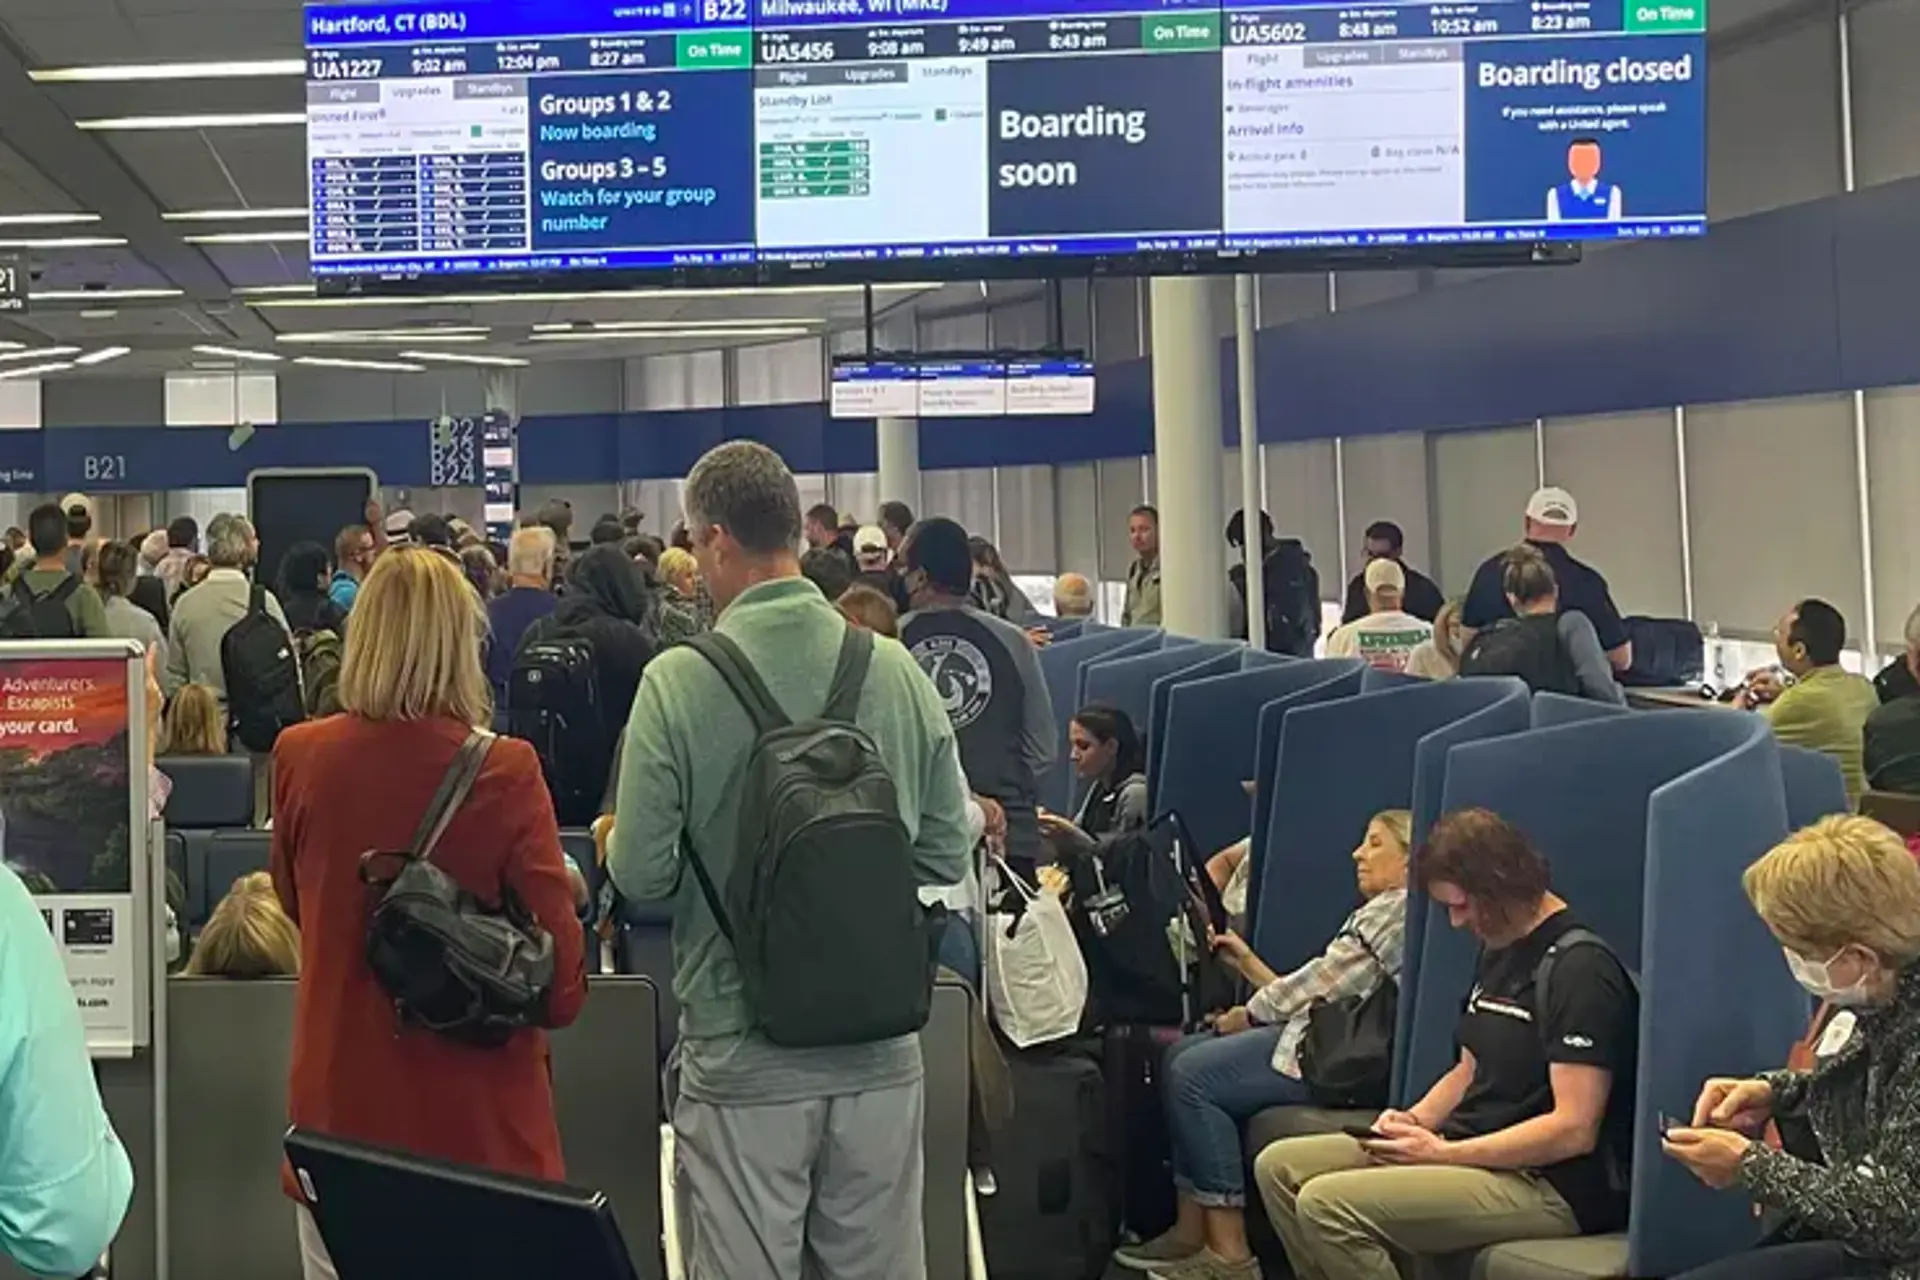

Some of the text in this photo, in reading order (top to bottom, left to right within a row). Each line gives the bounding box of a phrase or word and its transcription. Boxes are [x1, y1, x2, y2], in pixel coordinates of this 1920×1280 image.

[703, 0, 747, 21] B22
[761, 0, 863, 16] Milwaukee,
[867, 0, 890, 13] WI
[1636, 6, 1695, 22] On Time
[311, 12, 467, 35] Hartford, CT (BDL)
[1372, 23, 1398, 35] am
[1430, 19, 1498, 34] 10:52 am
[1531, 15, 1591, 30] 8:23 am
[1153, 25, 1210, 40] On Time
[1230, 23, 1306, 43] UA5602
[900, 42, 925, 54] am
[958, 37, 1015, 53] 9:49 am
[1049, 34, 1107, 49] 8:43 am
[687, 43, 742, 57] On Time
[761, 42, 834, 61] UA5456
[1315, 49, 1370, 64] Upgrades
[1398, 47, 1449, 60] Standbys
[412, 60, 467, 73] 9:02 am
[497, 56, 560, 70] 12:04 pm
[590, 52, 645, 67] 8:27 am
[1247, 53, 1279, 66] Flight
[312, 60, 383, 79] UA1227
[845, 68, 896, 84] Upgrades
[922, 66, 973, 78] Standbys
[1478, 53, 1692, 90] Boarding closed
[779, 71, 808, 85] Flight
[1285, 74, 1354, 90] amenities
[391, 86, 442, 100] Upgrades
[759, 93, 833, 108] Standby List
[540, 89, 672, 118] Groups 1 & 2
[1510, 107, 1527, 119] you
[1529, 105, 1554, 115] need
[1607, 103, 1637, 116] please
[1638, 101, 1667, 114] speak
[540, 124, 579, 140] Now
[581, 120, 657, 142] boarding
[1000, 104, 1147, 144] Boarding
[1227, 121, 1304, 137] Arrival info
[1537, 119, 1559, 131] with
[1568, 118, 1600, 130] United
[540, 160, 617, 184] Groups
[620, 156, 634, 178] 3
[652, 155, 667, 178] 5
[999, 160, 1077, 188] soon
[540, 187, 716, 208] Watch for your group
[541, 214, 609, 232] number
[84, 455, 126, 480] B21
[431, 462, 475, 485] B24
[38, 718, 79, 734] card.
